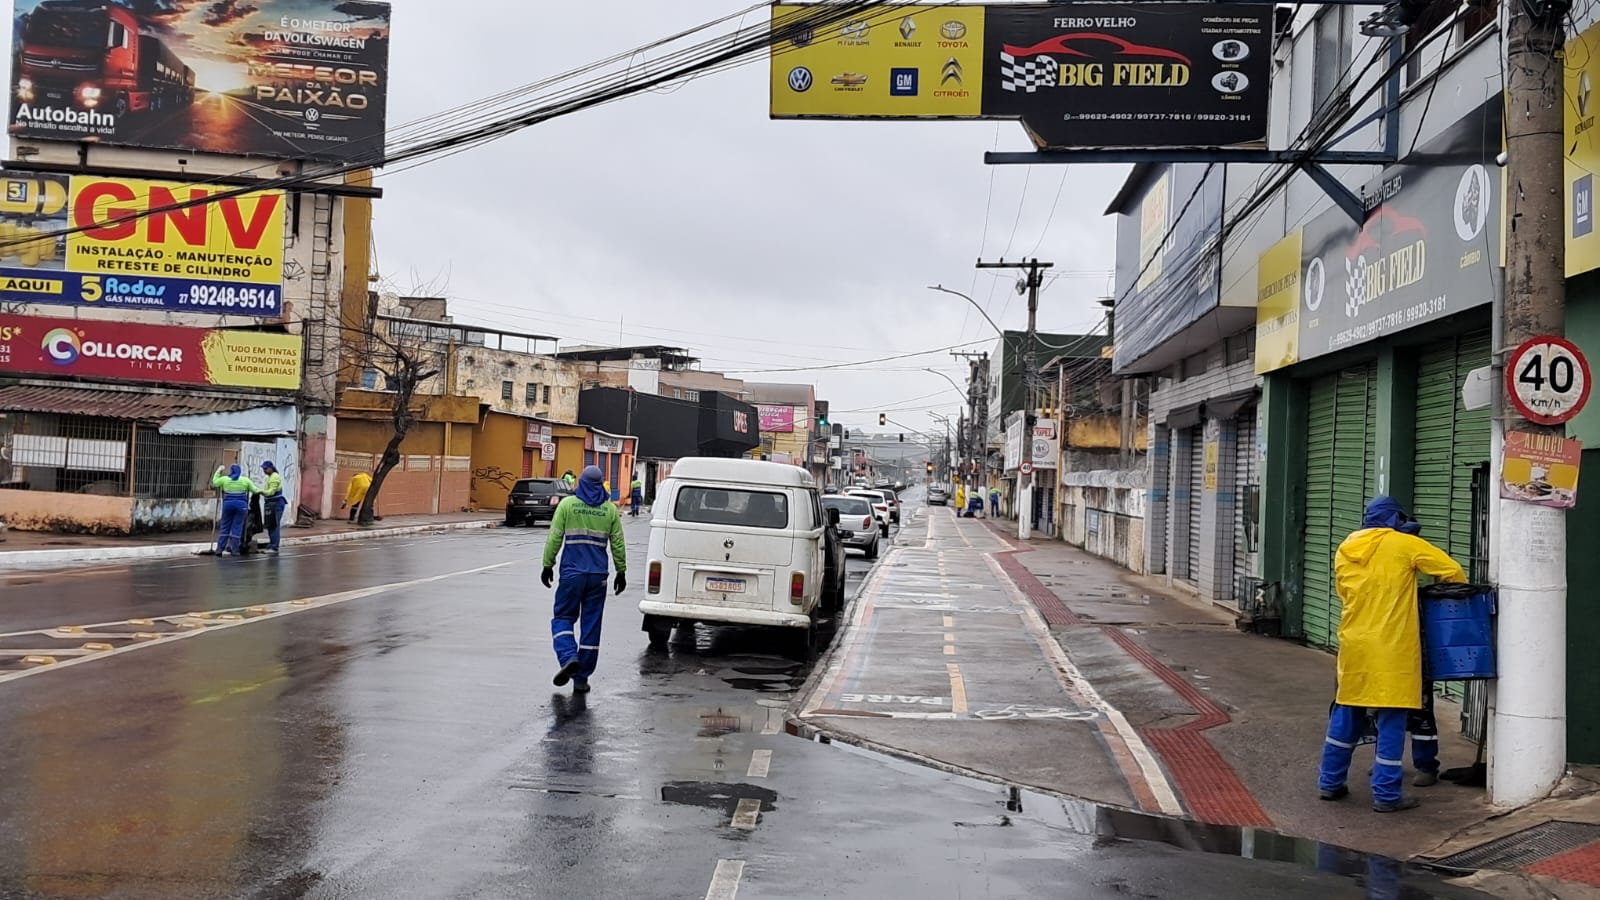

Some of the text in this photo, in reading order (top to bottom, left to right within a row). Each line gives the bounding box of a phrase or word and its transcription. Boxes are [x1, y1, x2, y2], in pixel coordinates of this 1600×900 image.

[302, 19, 351, 32] METEOR
[1054, 17, 1136, 28] FERRO VELHO
[264, 31, 365, 49] DA VOLKSWAGEN
[247, 60, 378, 86] METEOR
[896, 74, 912, 87] GM
[1058, 63, 1190, 87] BIG FIELD
[256, 85, 368, 110] PAIXÃO
[16, 103, 115, 127] Autobahn
[59, 122, 89, 132] escolha
[1576, 190, 1589, 217] GM
[73, 181, 280, 250] GNV
[76, 245, 164, 261] INSTALAÇÃO
[176, 251, 272, 267] MANUTENÇÃO
[97, 259, 251, 278] RETESTE DE CILINDRO
[1367, 239, 1425, 303] BIG FIELD
[6, 279, 50, 291] AQUI
[80, 275, 166, 302] 5 Rodas
[124, 295, 164, 306] NATURAL
[179, 285, 275, 309] 27 99248-9514
[226, 345, 297, 357] TUDO EM TINTAS
[130, 360, 181, 372] TINTAS
[234, 355, 297, 366] AUTOMOTIVAS
[228, 364, 296, 376] E IMOBILIARIAS!
[1519, 354, 1574, 393] 40
[1531, 398, 1561, 409] km/h
[840, 693, 943, 705] PARE
